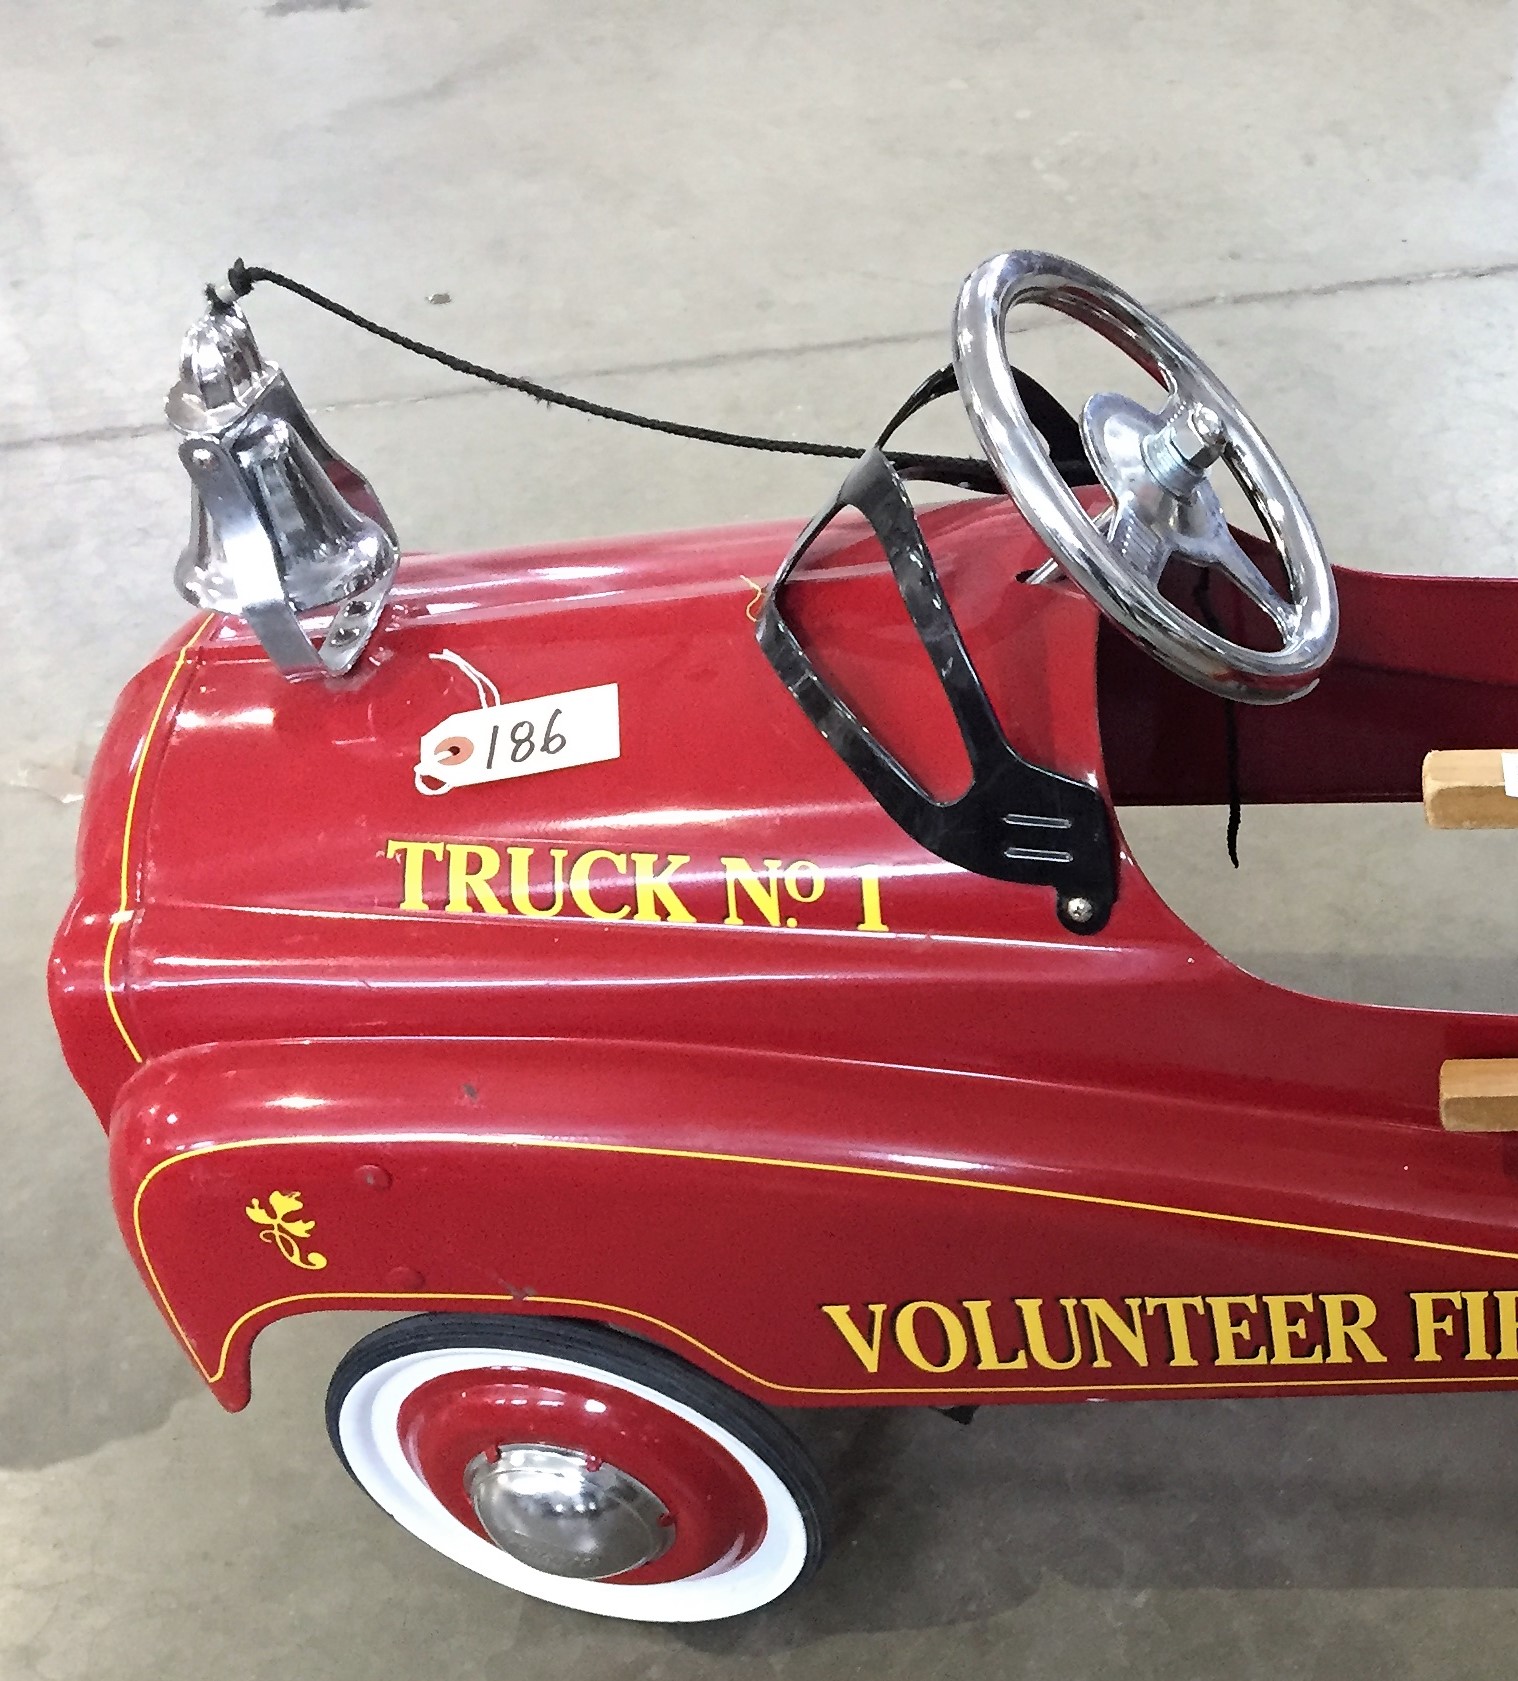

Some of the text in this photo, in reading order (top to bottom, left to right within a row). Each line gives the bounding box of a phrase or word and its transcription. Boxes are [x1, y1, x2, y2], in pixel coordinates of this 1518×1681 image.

[486, 708, 567, 770] 186
[386, 839, 698, 924] TRUCK
[822, 1293, 1388, 1374] VOLUNTEER
